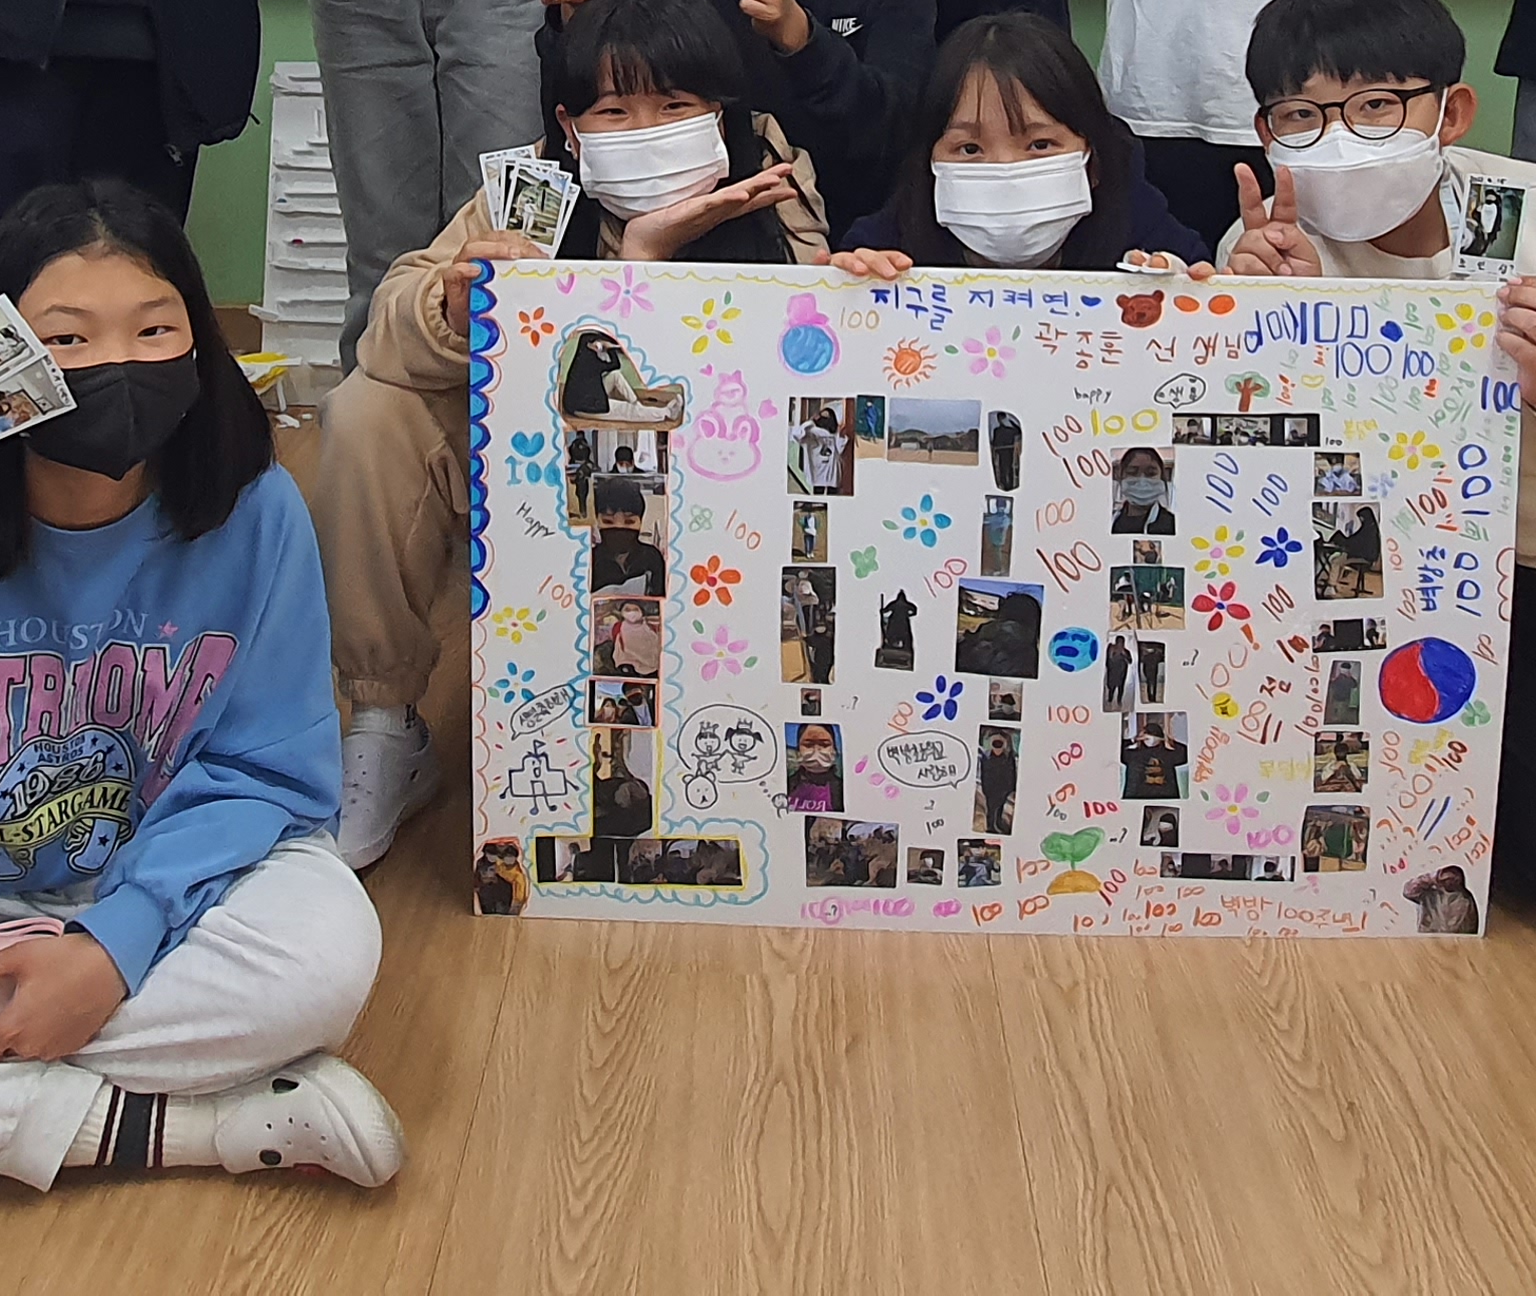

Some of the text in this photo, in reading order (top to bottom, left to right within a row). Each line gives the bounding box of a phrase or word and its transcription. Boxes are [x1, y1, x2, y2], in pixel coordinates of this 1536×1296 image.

[840, 306, 880, 330] 100
[870, 284, 953, 331] 지구를
[1336, 341, 1393, 379] 100
[1401, 342, 1436, 380] 100
[1041, 414, 1083, 459] 100
[1091, 408, 1160, 437] 100
[1325, 436, 1344, 447] 100
[1062, 448, 1112, 490] 100
[1206, 451, 1239, 514] 100
[1457, 443, 1493, 516] 100
[1251, 473, 1289, 517] 100
[515, 501, 556, 538] Happy
[725, 508, 762, 550] 100
[1036, 497, 1076, 533] 100
[923, 557, 968, 598] 100
[1035, 540, 1103, 594] 100
[538, 574, 573, 608] 100
[1453, 551, 1483, 618] 100
[1261, 583, 1295, 623] 100
[887, 701, 913, 735] 100
[1048, 705, 1090, 724] 100
[1051, 742, 1083, 771] 100
[1441, 740, 1468, 772] 100
[1083, 799, 1119, 819] 100
[1385, 773, 1433, 825] 100
[925, 818, 945, 835] 100
[1246, 824, 1296, 850] 100
[1016, 857, 1052, 884] 100
[1382, 858, 1407, 874] 100
[1098, 868, 1127, 906] 100
[1177, 886, 1206, 900] 100
[971, 903, 1004, 927] 100
[1018, 895, 1051, 921] 100
[1145, 900, 1177, 920] 100
[1193, 906, 1223, 927] 100
